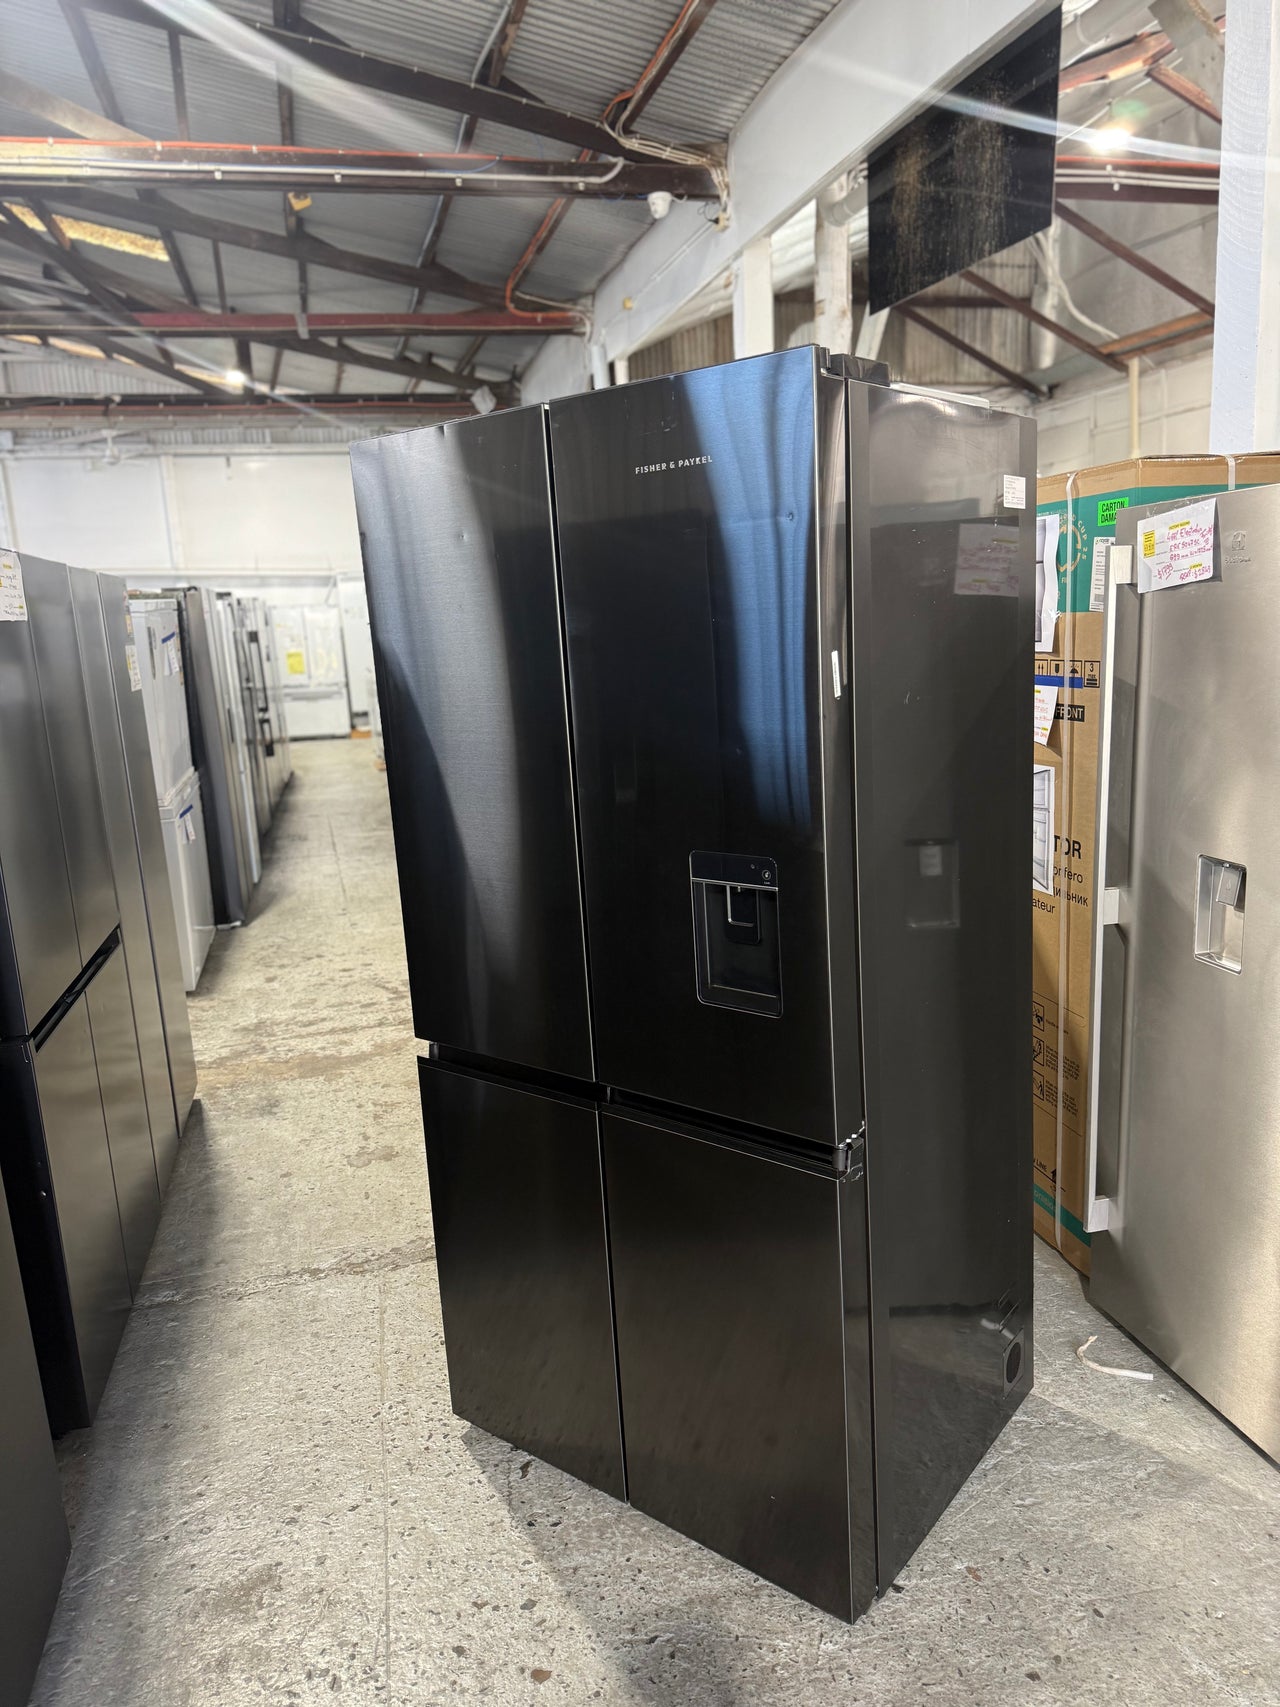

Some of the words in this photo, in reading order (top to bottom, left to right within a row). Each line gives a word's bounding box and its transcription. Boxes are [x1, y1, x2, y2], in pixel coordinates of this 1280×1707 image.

[635, 462, 667, 475] FISHER
[669, 461, 675, 469] &
[678, 455, 713, 468] PAYKEL
[1101, 501, 1125, 513] CARTON
[1101, 513, 1117, 524] DAMA
[1089, 662, 1094, 673] 3
[1055, 706, 1084, 720] FRONT
[1054, 834, 1082, 860] TOR
[1032, 898, 1056, 914] ateur
